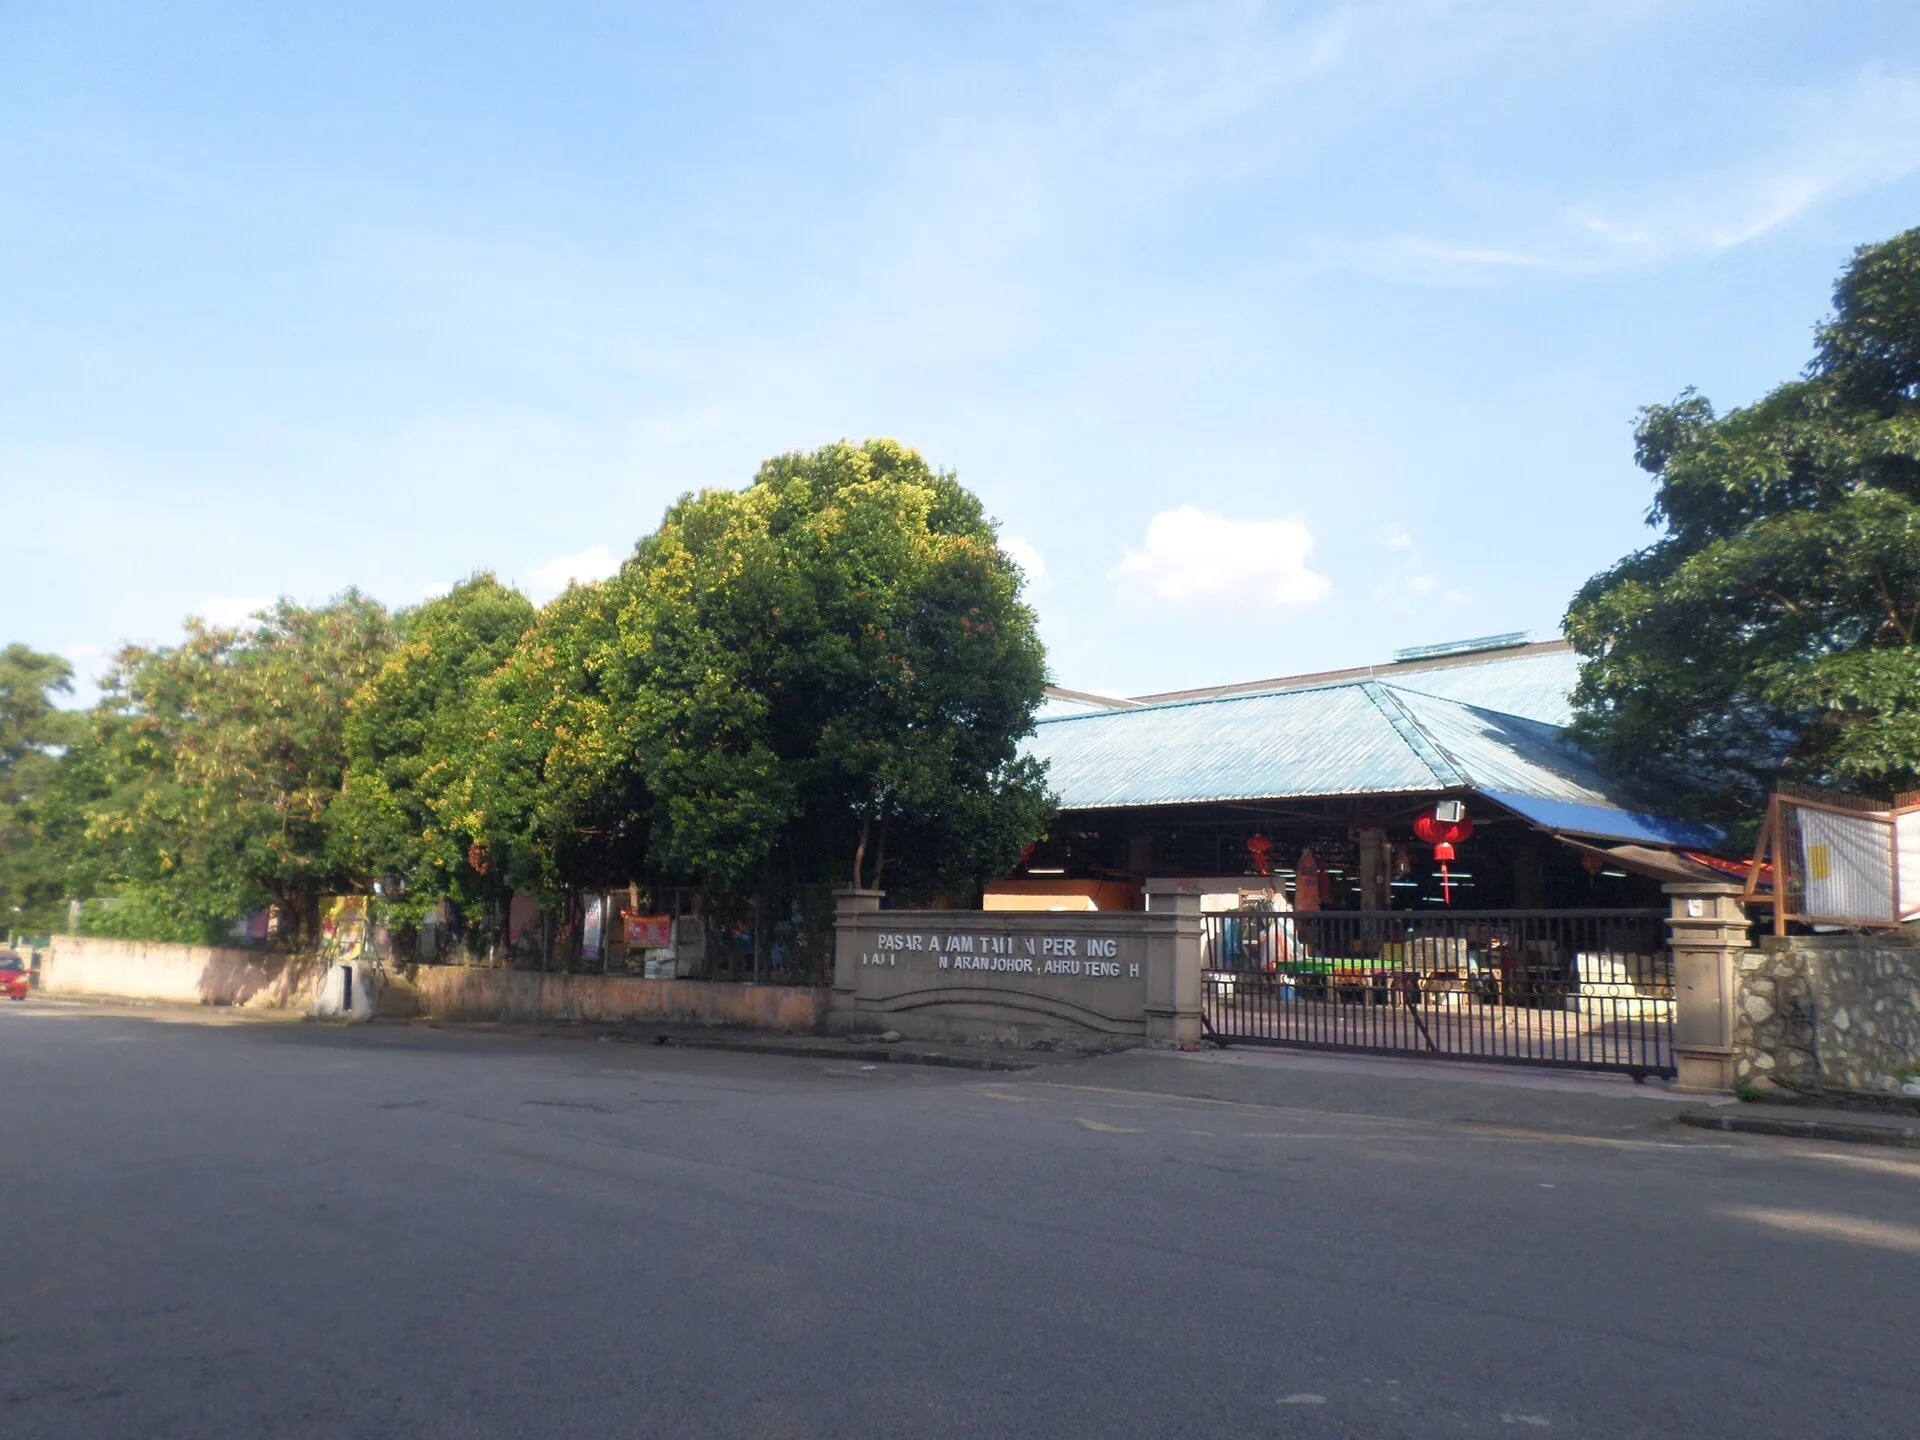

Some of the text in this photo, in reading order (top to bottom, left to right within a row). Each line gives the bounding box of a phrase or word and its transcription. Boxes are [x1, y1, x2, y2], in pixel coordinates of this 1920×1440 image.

[929, 935, 973, 953] AAM
[1043, 938, 1117, 957] PERING
[1038, 960, 1080, 975] AHRU
[1084, 961, 1139, 978] TENGH
